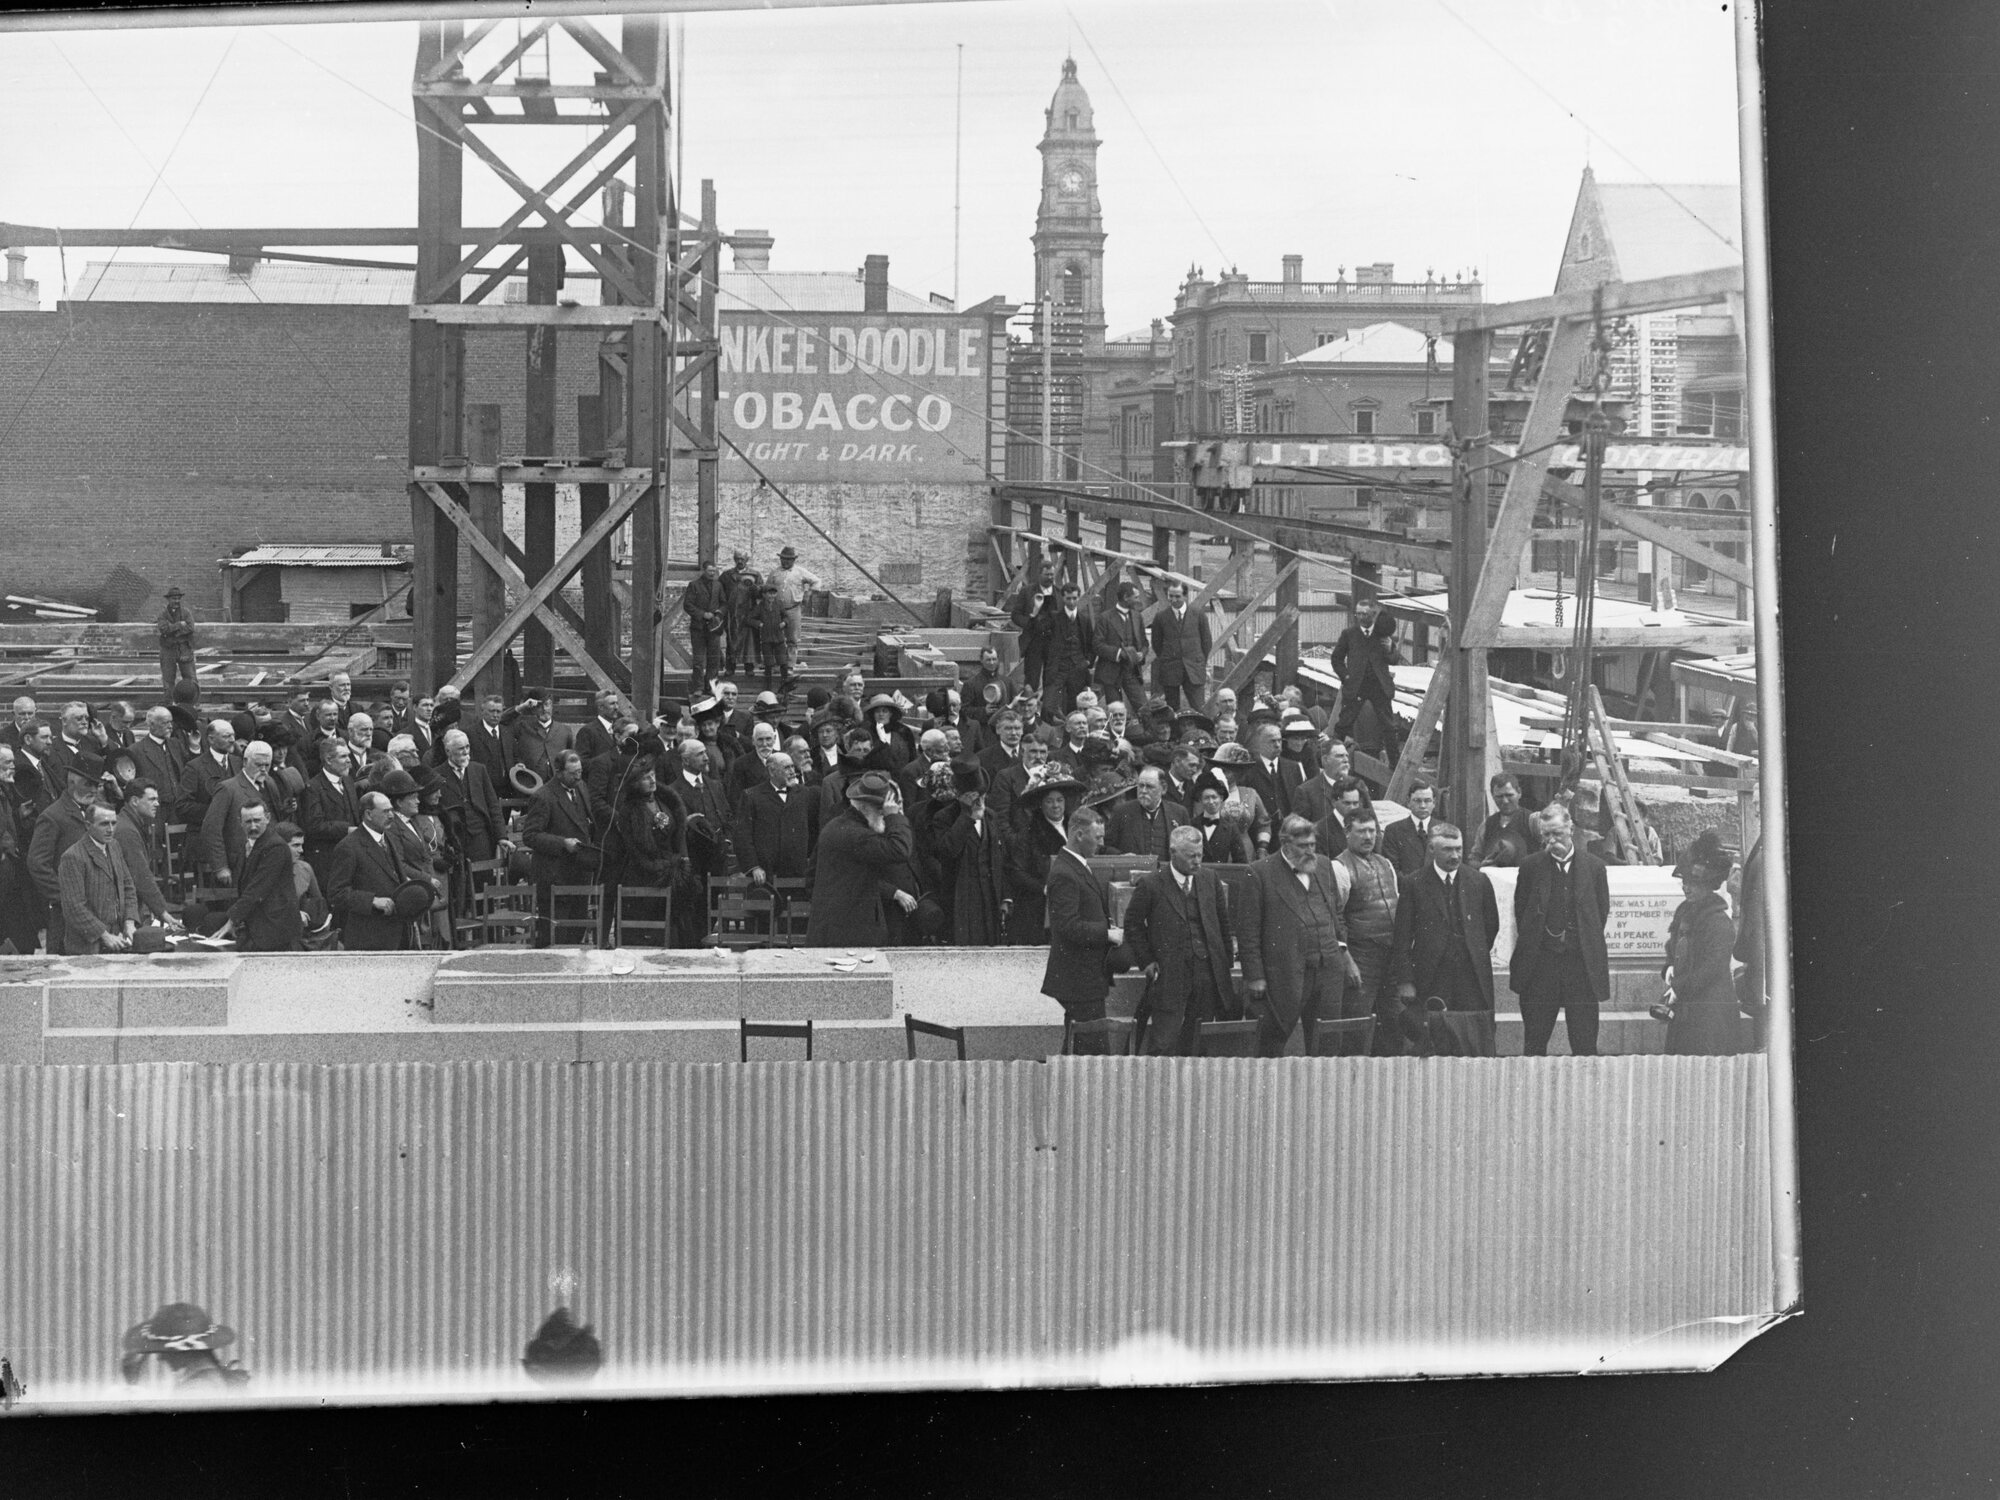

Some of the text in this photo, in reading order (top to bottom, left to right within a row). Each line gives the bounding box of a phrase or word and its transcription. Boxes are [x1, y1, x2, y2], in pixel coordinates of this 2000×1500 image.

[676, 325, 982, 376] NKEE DOODLE
[726, 442, 924, 462] LIGHT & DARK.
[1348, 444, 1452, 466] BRO
[1615, 910, 1661, 918] SEPTEMBER
[1616, 921, 1627, 929] BY
